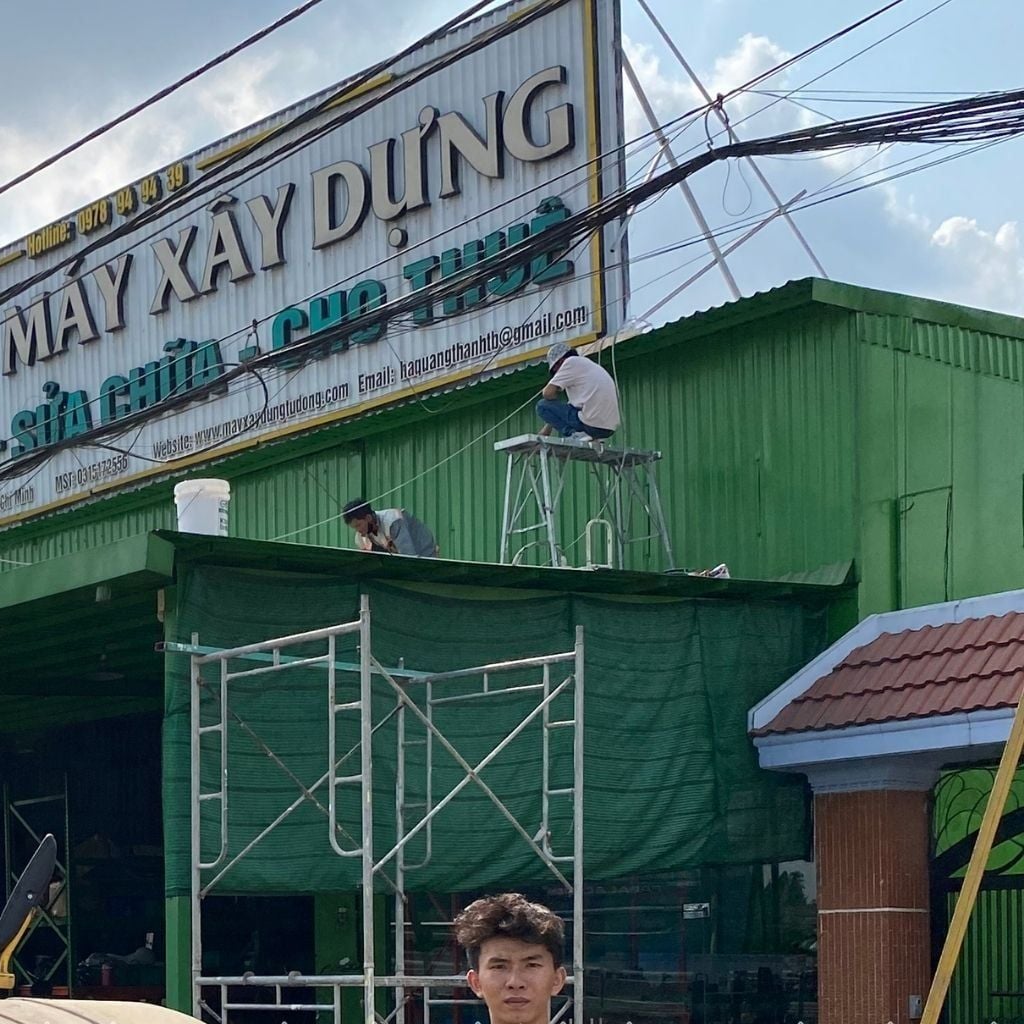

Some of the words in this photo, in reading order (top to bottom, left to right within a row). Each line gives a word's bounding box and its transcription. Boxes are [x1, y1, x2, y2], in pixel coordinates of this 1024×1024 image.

[2, 255, 133, 376] MÁY
[149, 183, 296, 315] XÂY
[311, 64, 575, 250] DỰNG
[27, 221, 73, 258] Hotline:
[78, 200, 111, 234] 0978
[116, 187, 137, 217] 94
[140, 176, 162, 204] 94
[166, 163, 188, 192] 39
[11, 381, 93, 460] SỬA
[100, 338, 224, 425] CHỮA
[272, 279, 387, 370] CHO
[404, 196, 575, 326] THUÊ
[152, 433, 193, 461] Website:
[358, 365, 396, 394] Email:
[399, 304, 588, 381] haquangthanhtb@gmail.com
[55, 474, 75, 493] MST:
